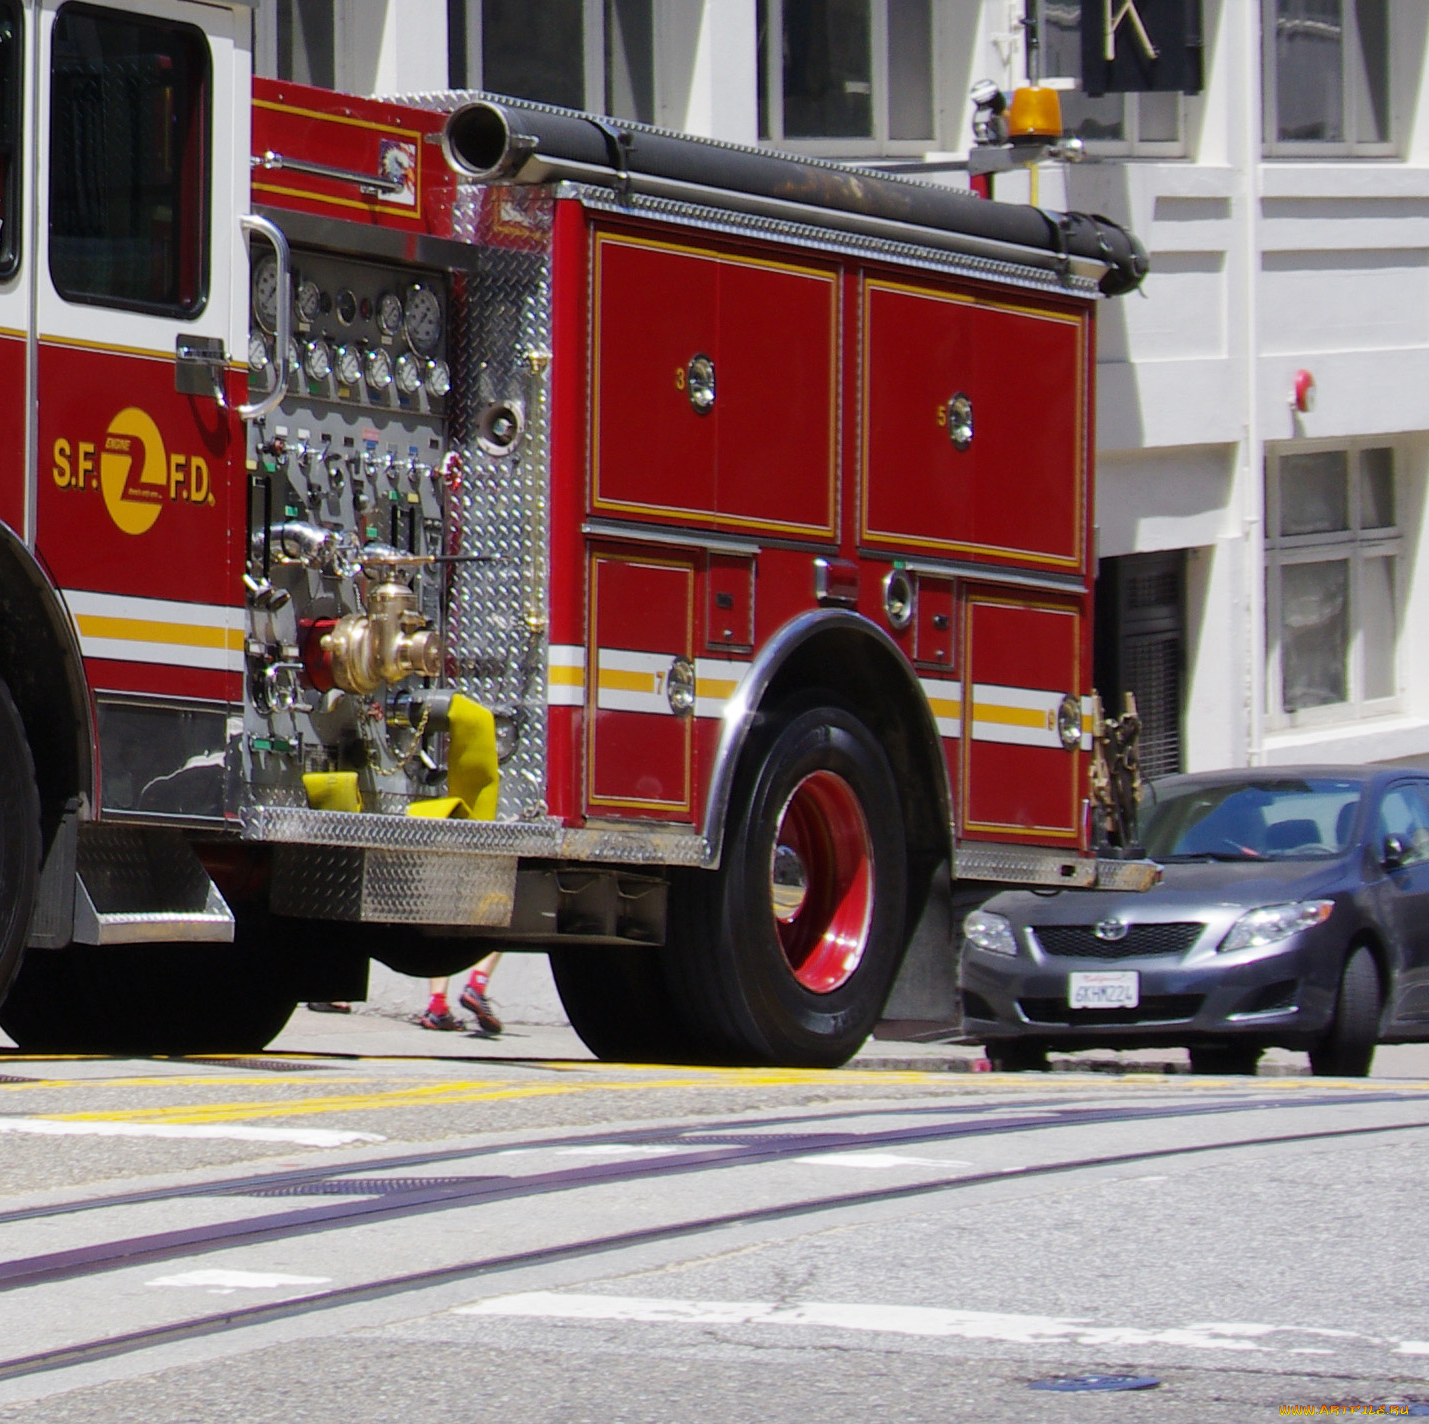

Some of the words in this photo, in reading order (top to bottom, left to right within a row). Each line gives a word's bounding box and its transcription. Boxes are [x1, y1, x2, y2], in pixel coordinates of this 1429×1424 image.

[676, 367, 685, 391] 3
[937, 406, 946, 427] 5
[655, 671, 665, 695] 7
